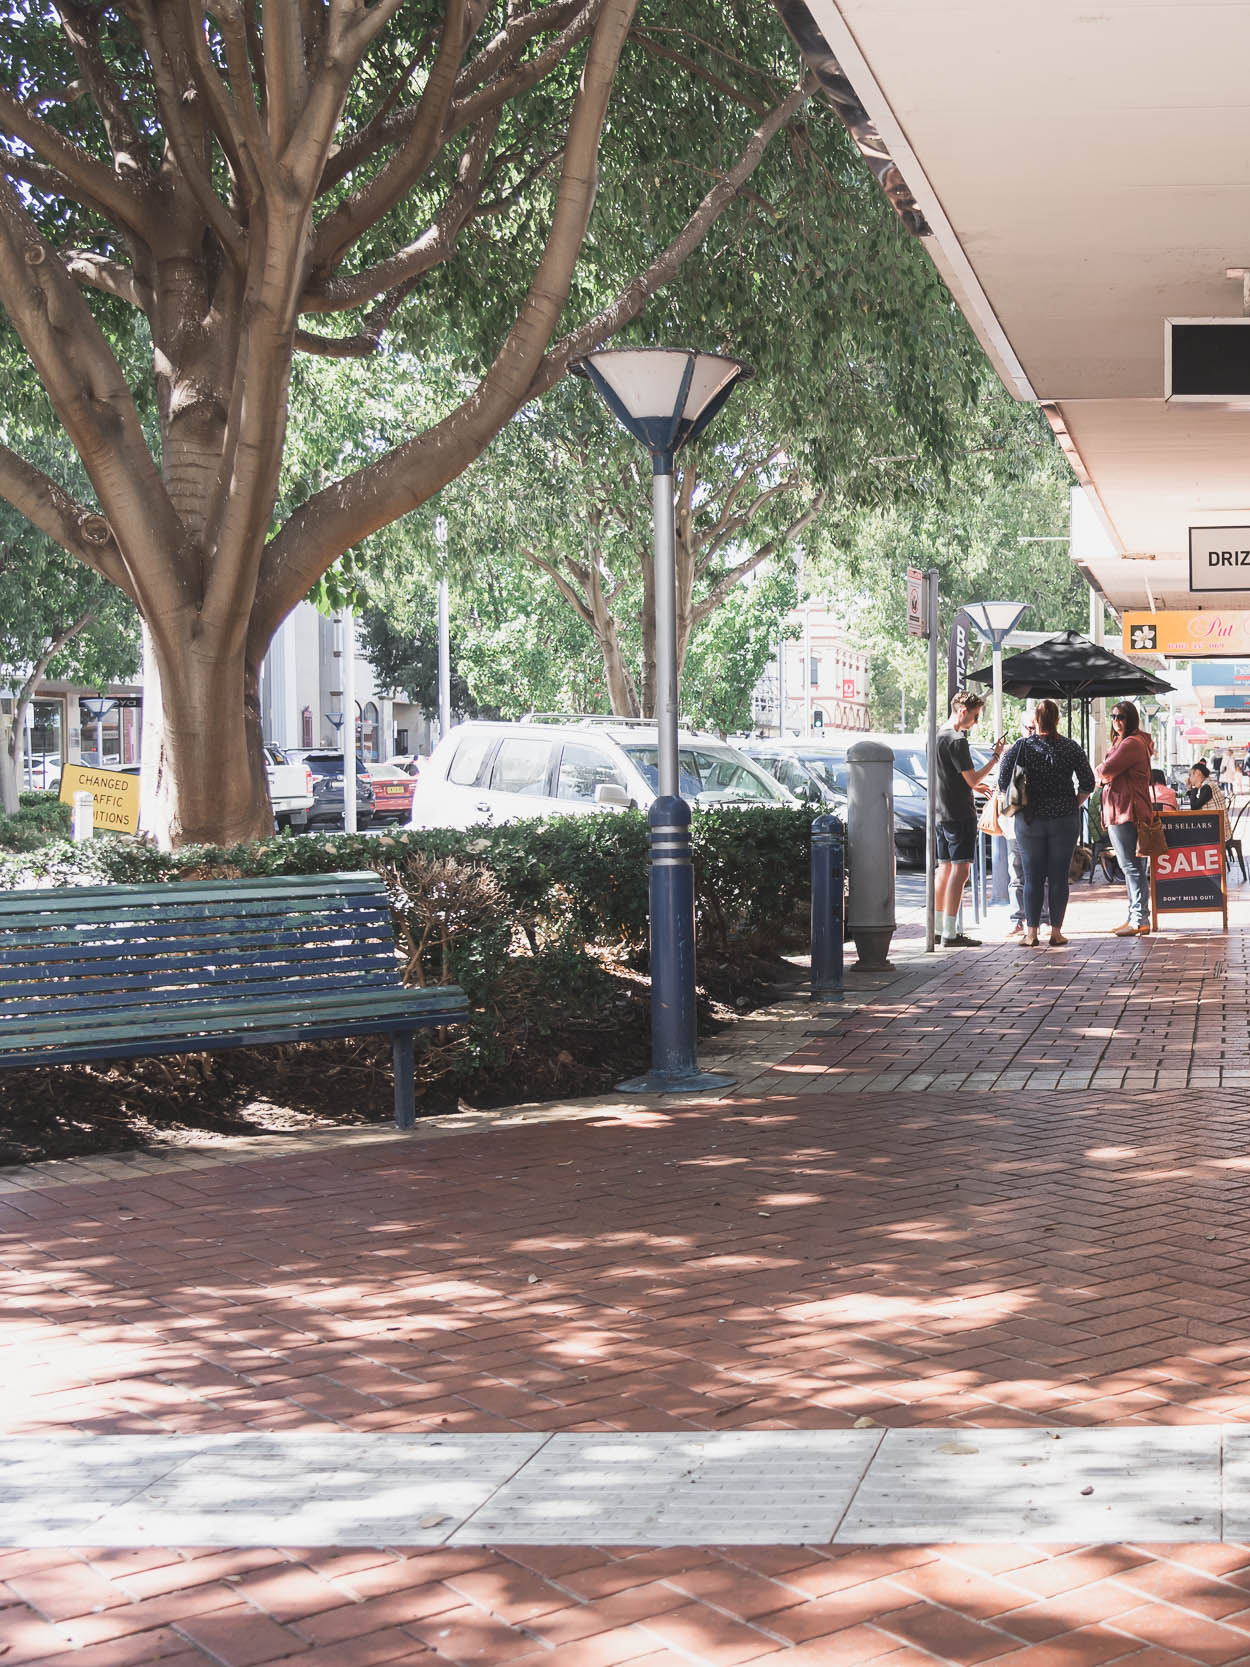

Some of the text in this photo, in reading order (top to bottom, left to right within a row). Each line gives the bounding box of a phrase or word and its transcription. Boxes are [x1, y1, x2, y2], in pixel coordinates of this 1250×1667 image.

[956, 625, 966, 691] BRE
[78, 774, 129, 791] CHANGED
[93, 793, 123, 808] AFFIC
[94, 810, 130, 825] ITIONS
[1157, 849, 1219, 875] SALE
